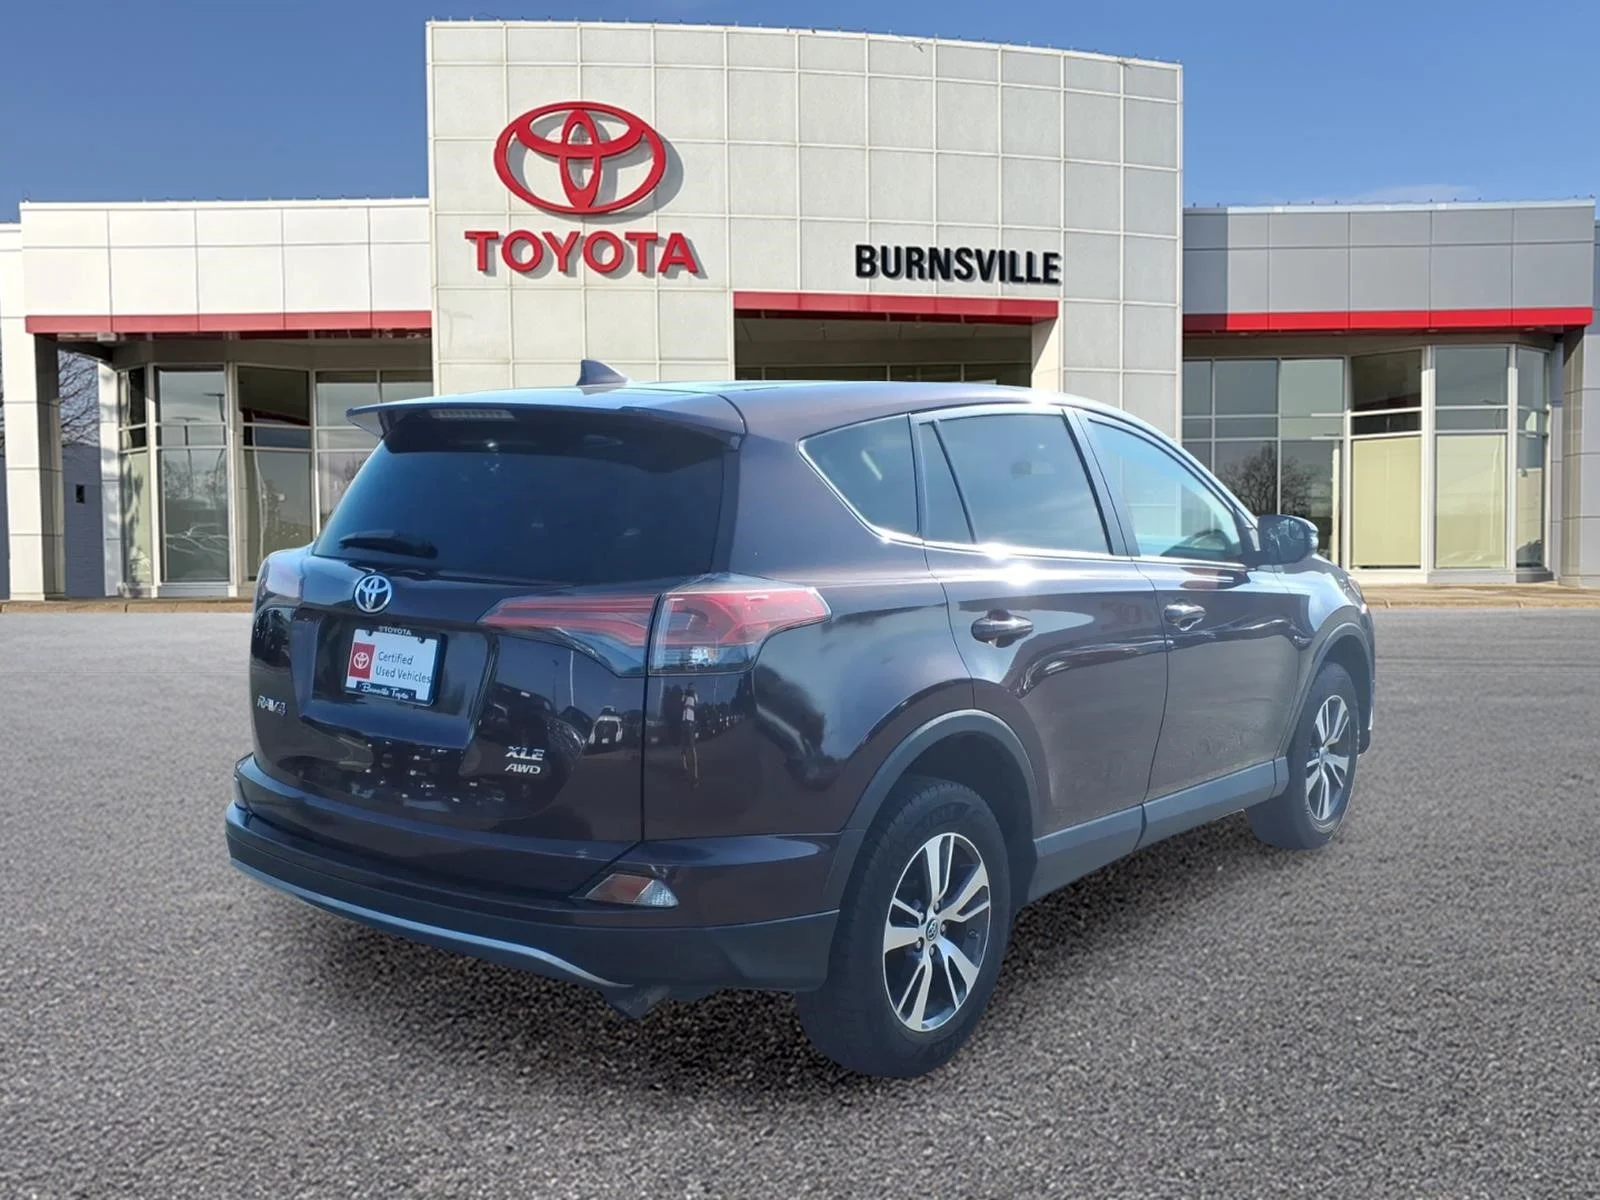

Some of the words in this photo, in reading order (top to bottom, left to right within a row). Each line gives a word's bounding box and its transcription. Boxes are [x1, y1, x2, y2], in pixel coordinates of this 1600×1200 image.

[465, 230, 699, 274] TOYOTA
[855, 244, 1062, 286] BURNSVILLE
[383, 626, 412, 636] TOYOTA
[378, 651, 414, 665] Certified
[376, 665, 396, 679] Used
[397, 669, 431, 684] Vehicles
[505, 745, 545, 761] XLE
[504, 763, 541, 775] AWD
